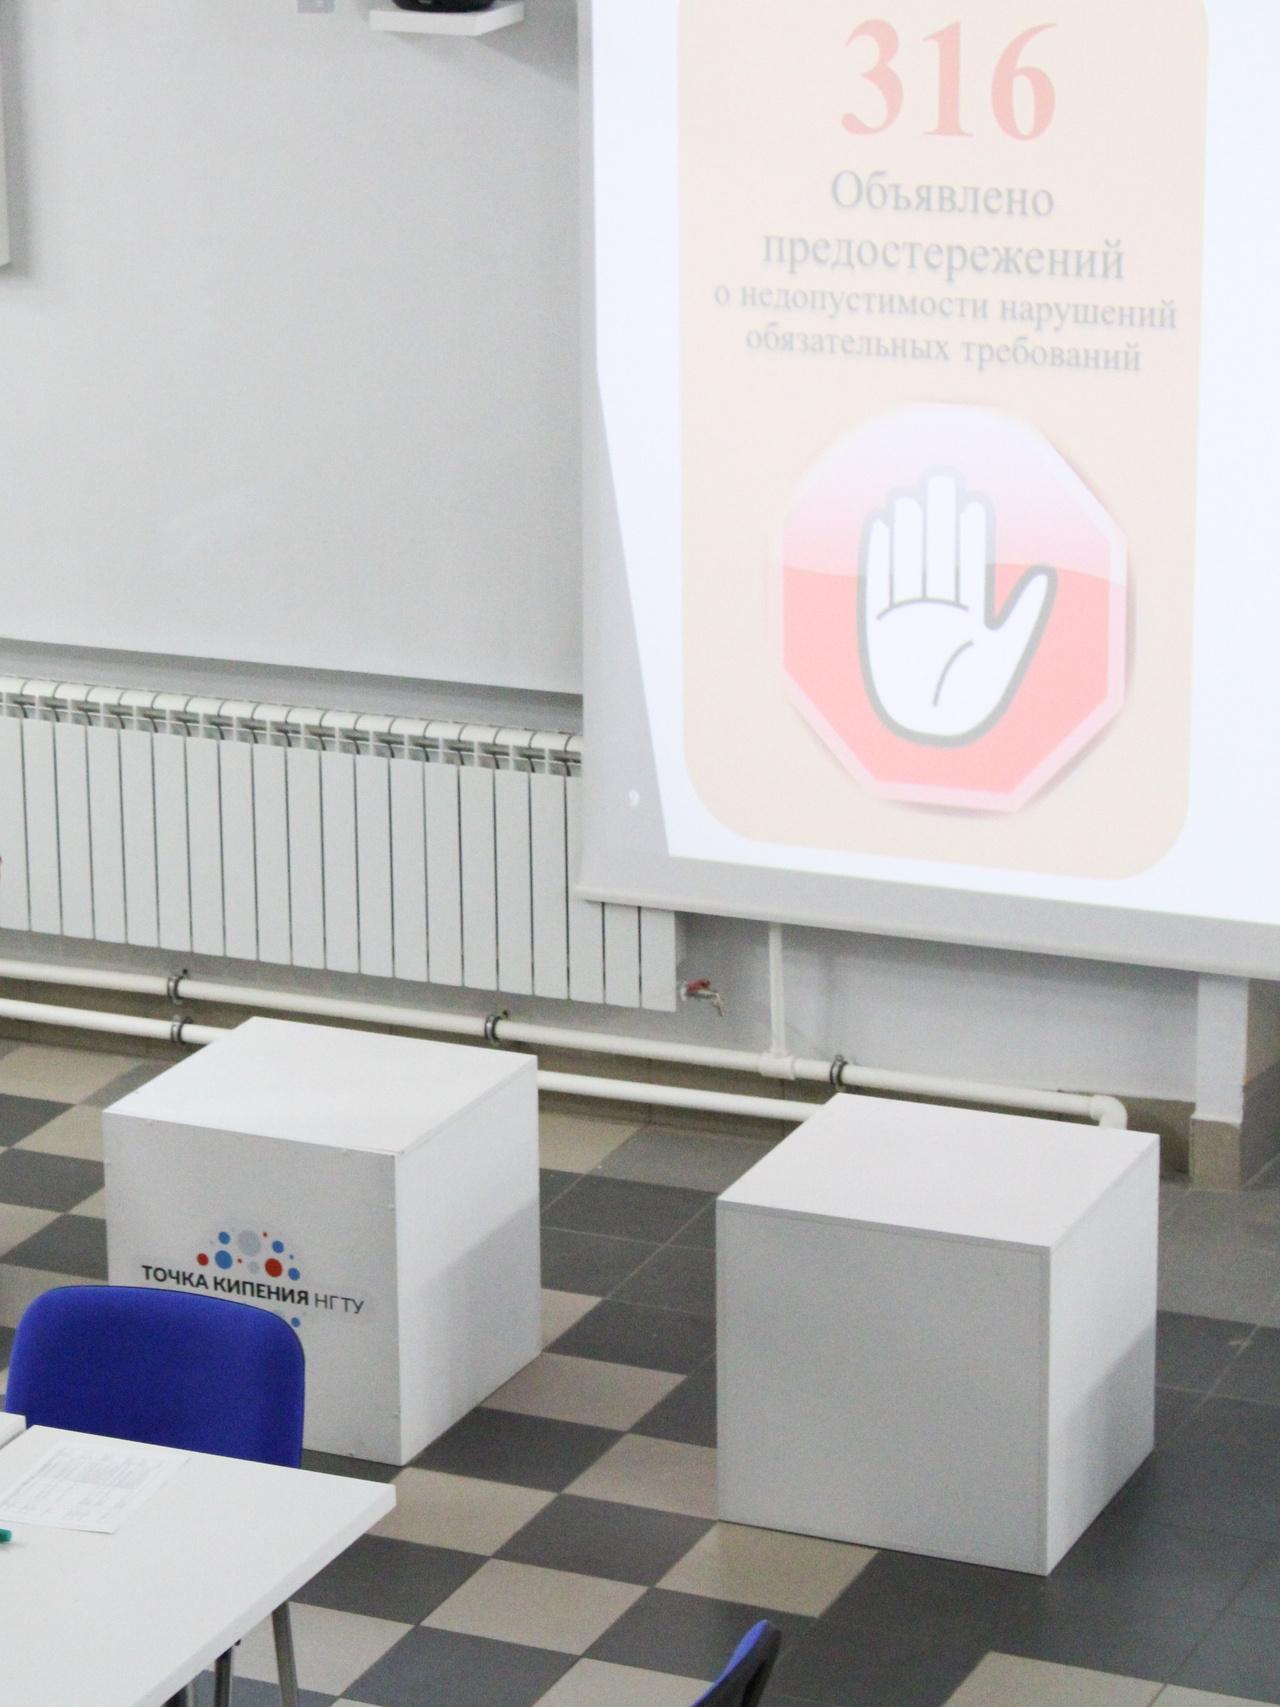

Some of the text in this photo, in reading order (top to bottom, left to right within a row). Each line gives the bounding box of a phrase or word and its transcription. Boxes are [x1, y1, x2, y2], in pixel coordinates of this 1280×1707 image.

[840, 18, 1058, 141] 316
[830, 169, 1055, 216] Объявлено
[763, 234, 1125, 283] предостережений
[713, 284, 1177, 332] о недопустимости нарушений
[745, 321, 1141, 372] обязательных требований
[141, 1265, 365, 1315] ТОЧКА КИПЕНИЯ НГТУ
